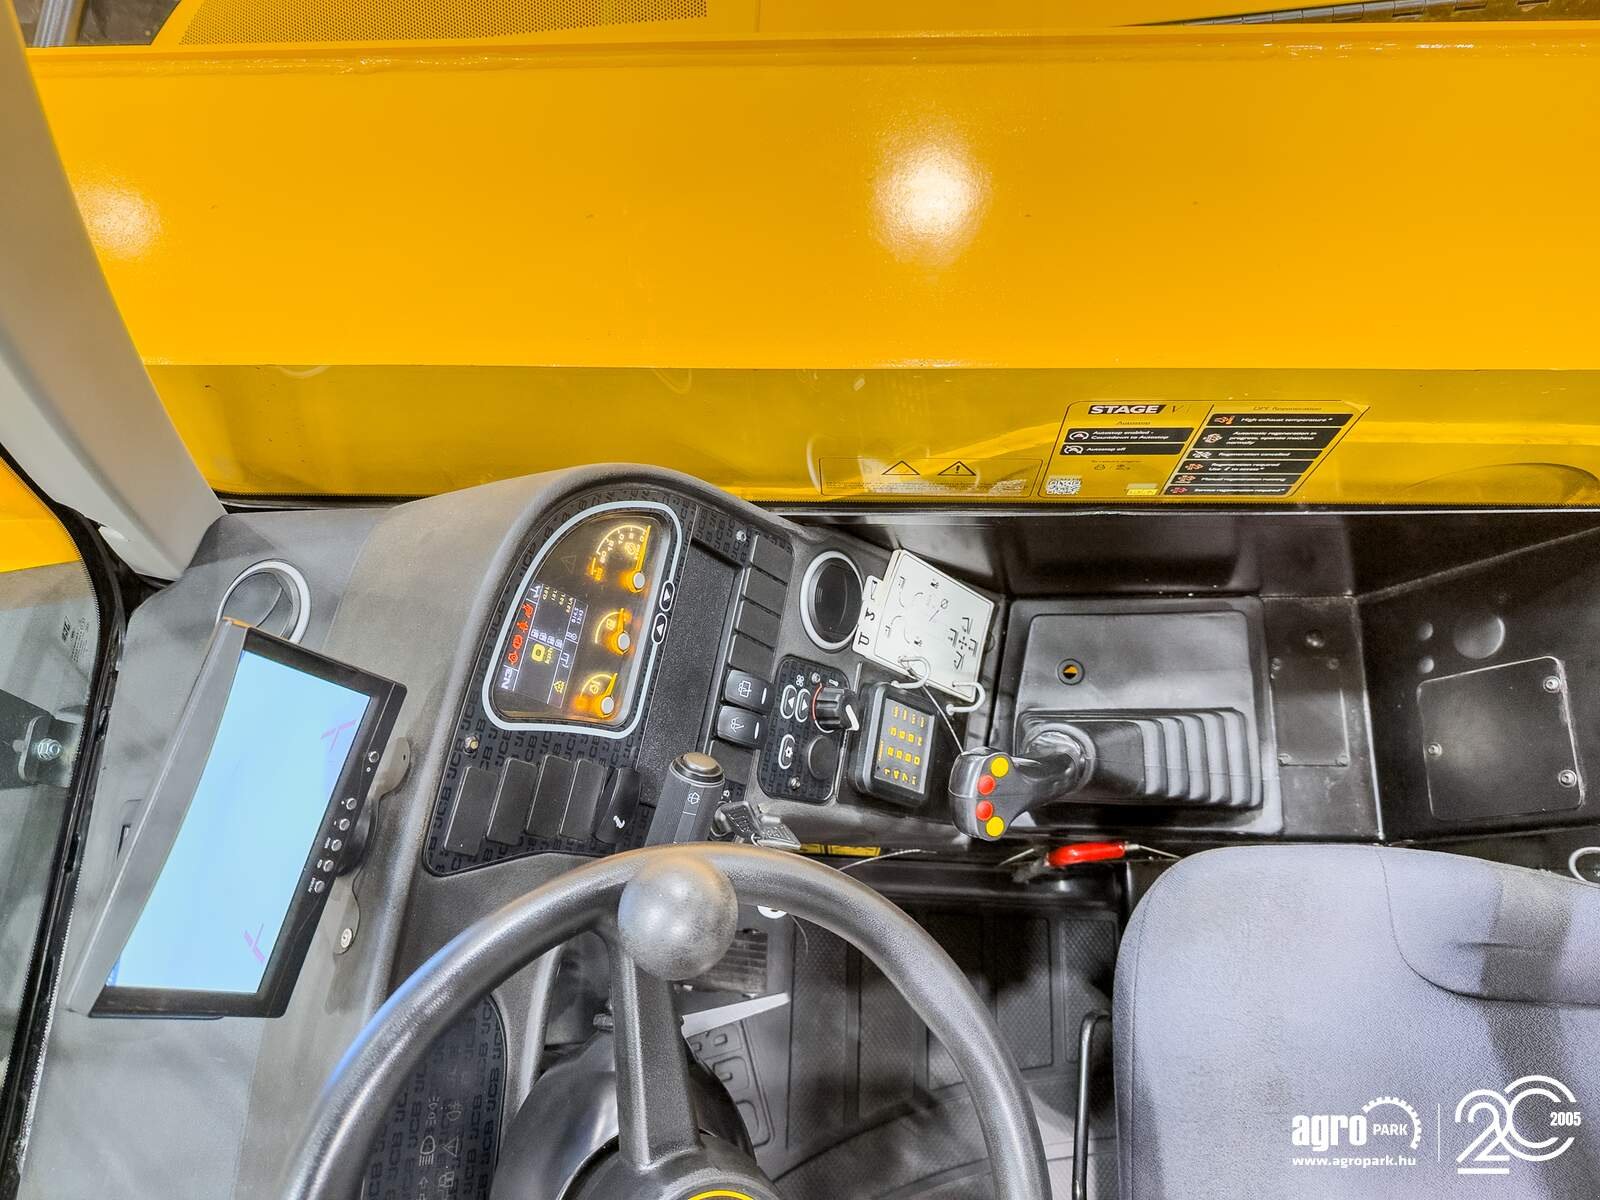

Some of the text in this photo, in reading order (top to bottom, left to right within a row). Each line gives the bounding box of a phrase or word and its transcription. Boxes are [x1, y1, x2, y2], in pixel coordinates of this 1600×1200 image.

[1090, 405, 1160, 414] STAGE
[447, 738, 465, 779] JCB
[433, 787, 452, 829] JCB
[487, 1067, 500, 1112] JCB
[407, 1100, 422, 1148] JCB
[470, 1094, 483, 1140] JCB
[388, 1132, 403, 1179] JCB
[480, 1119, 494, 1164] JCB
[463, 1148, 476, 1194] JCB
